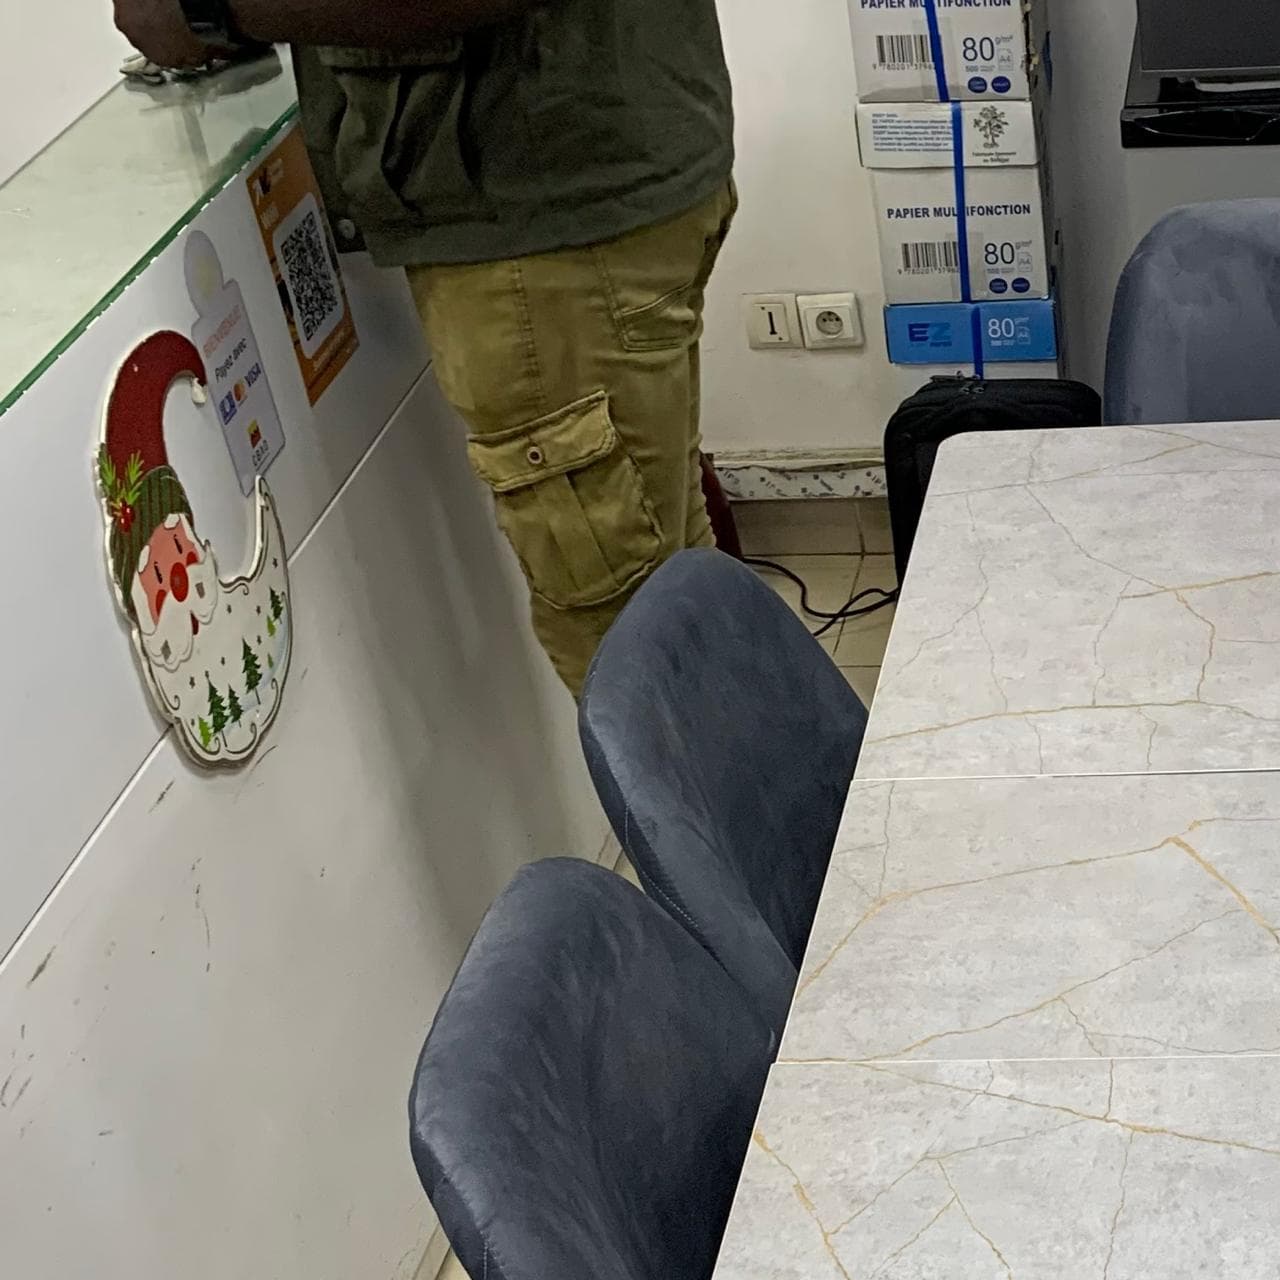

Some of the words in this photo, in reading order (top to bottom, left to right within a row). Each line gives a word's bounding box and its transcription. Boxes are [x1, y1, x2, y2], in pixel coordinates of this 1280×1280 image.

[909, 0, 1011, 8] MUTIFONCTION
[963, 37, 995, 62] 80
[887, 207, 930, 219] PAPIER
[933, 204, 1031, 218] MULIFONCTION
[984, 242, 1015, 265] 80
[988, 318, 1015, 338] 80
[244, 362, 262, 388] VISA
